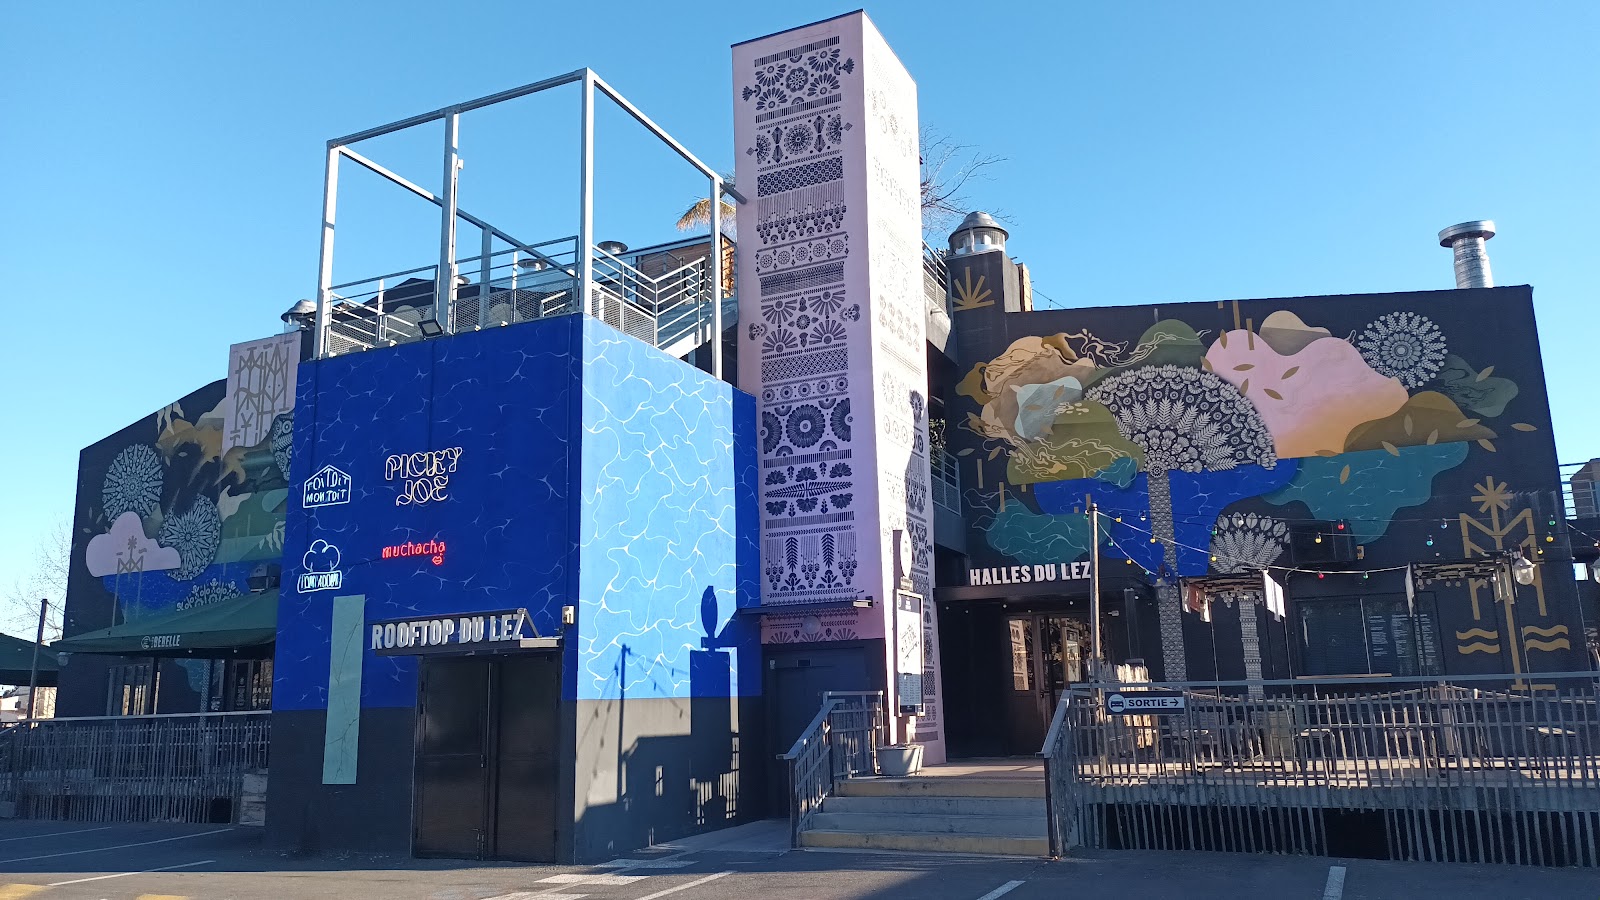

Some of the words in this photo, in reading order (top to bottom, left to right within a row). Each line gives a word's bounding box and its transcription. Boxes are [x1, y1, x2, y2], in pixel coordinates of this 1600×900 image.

[396, 475, 449, 506] JOE
[382, 540, 446, 558] muchacha
[969, 565, 1032, 586] HALLES
[1033, 563, 1057, 582] DU
[1060, 561, 1091, 580] LEZ
[371, 618, 455, 650] ROOFTOP
[458, 616, 485, 644] DU
[488, 612, 525, 642] LEZ
[1128, 698, 1168, 707] SORTIE
